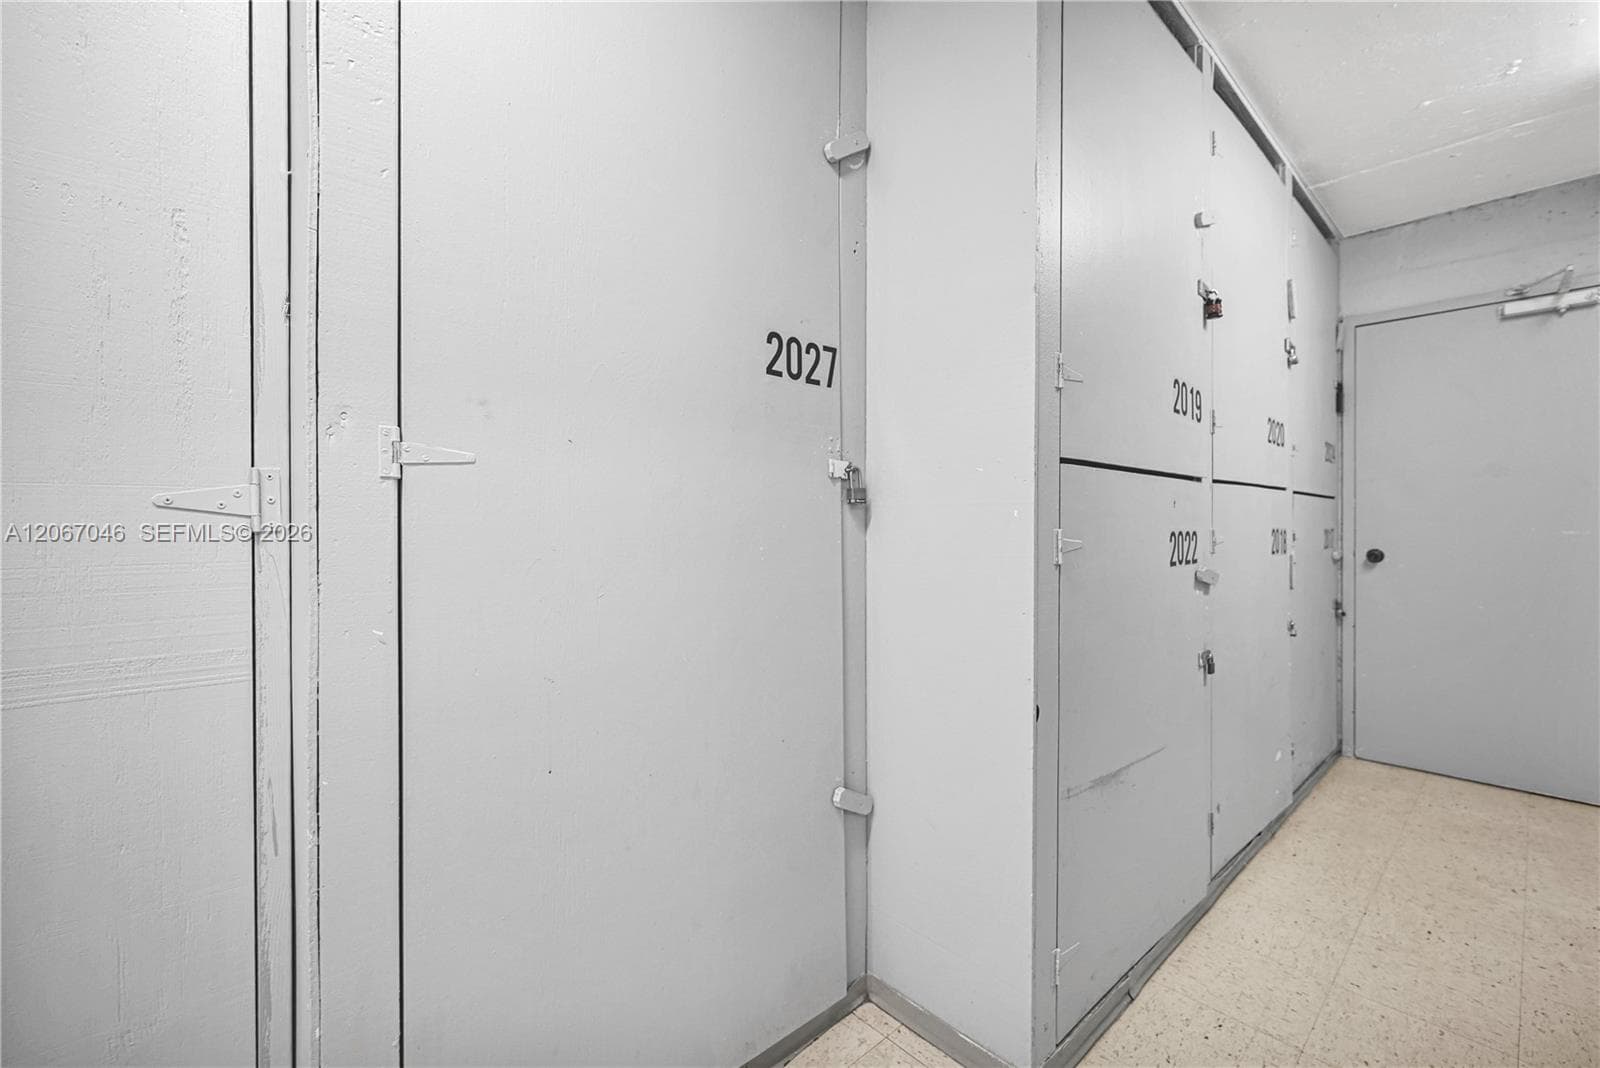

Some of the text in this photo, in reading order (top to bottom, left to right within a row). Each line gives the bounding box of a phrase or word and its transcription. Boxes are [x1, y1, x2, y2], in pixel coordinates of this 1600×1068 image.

[766, 331, 838, 388] 2027
[1173, 378, 1202, 423] 2019
[1267, 417, 1285, 447] 2020
[1169, 530, 1198, 567] 2022
